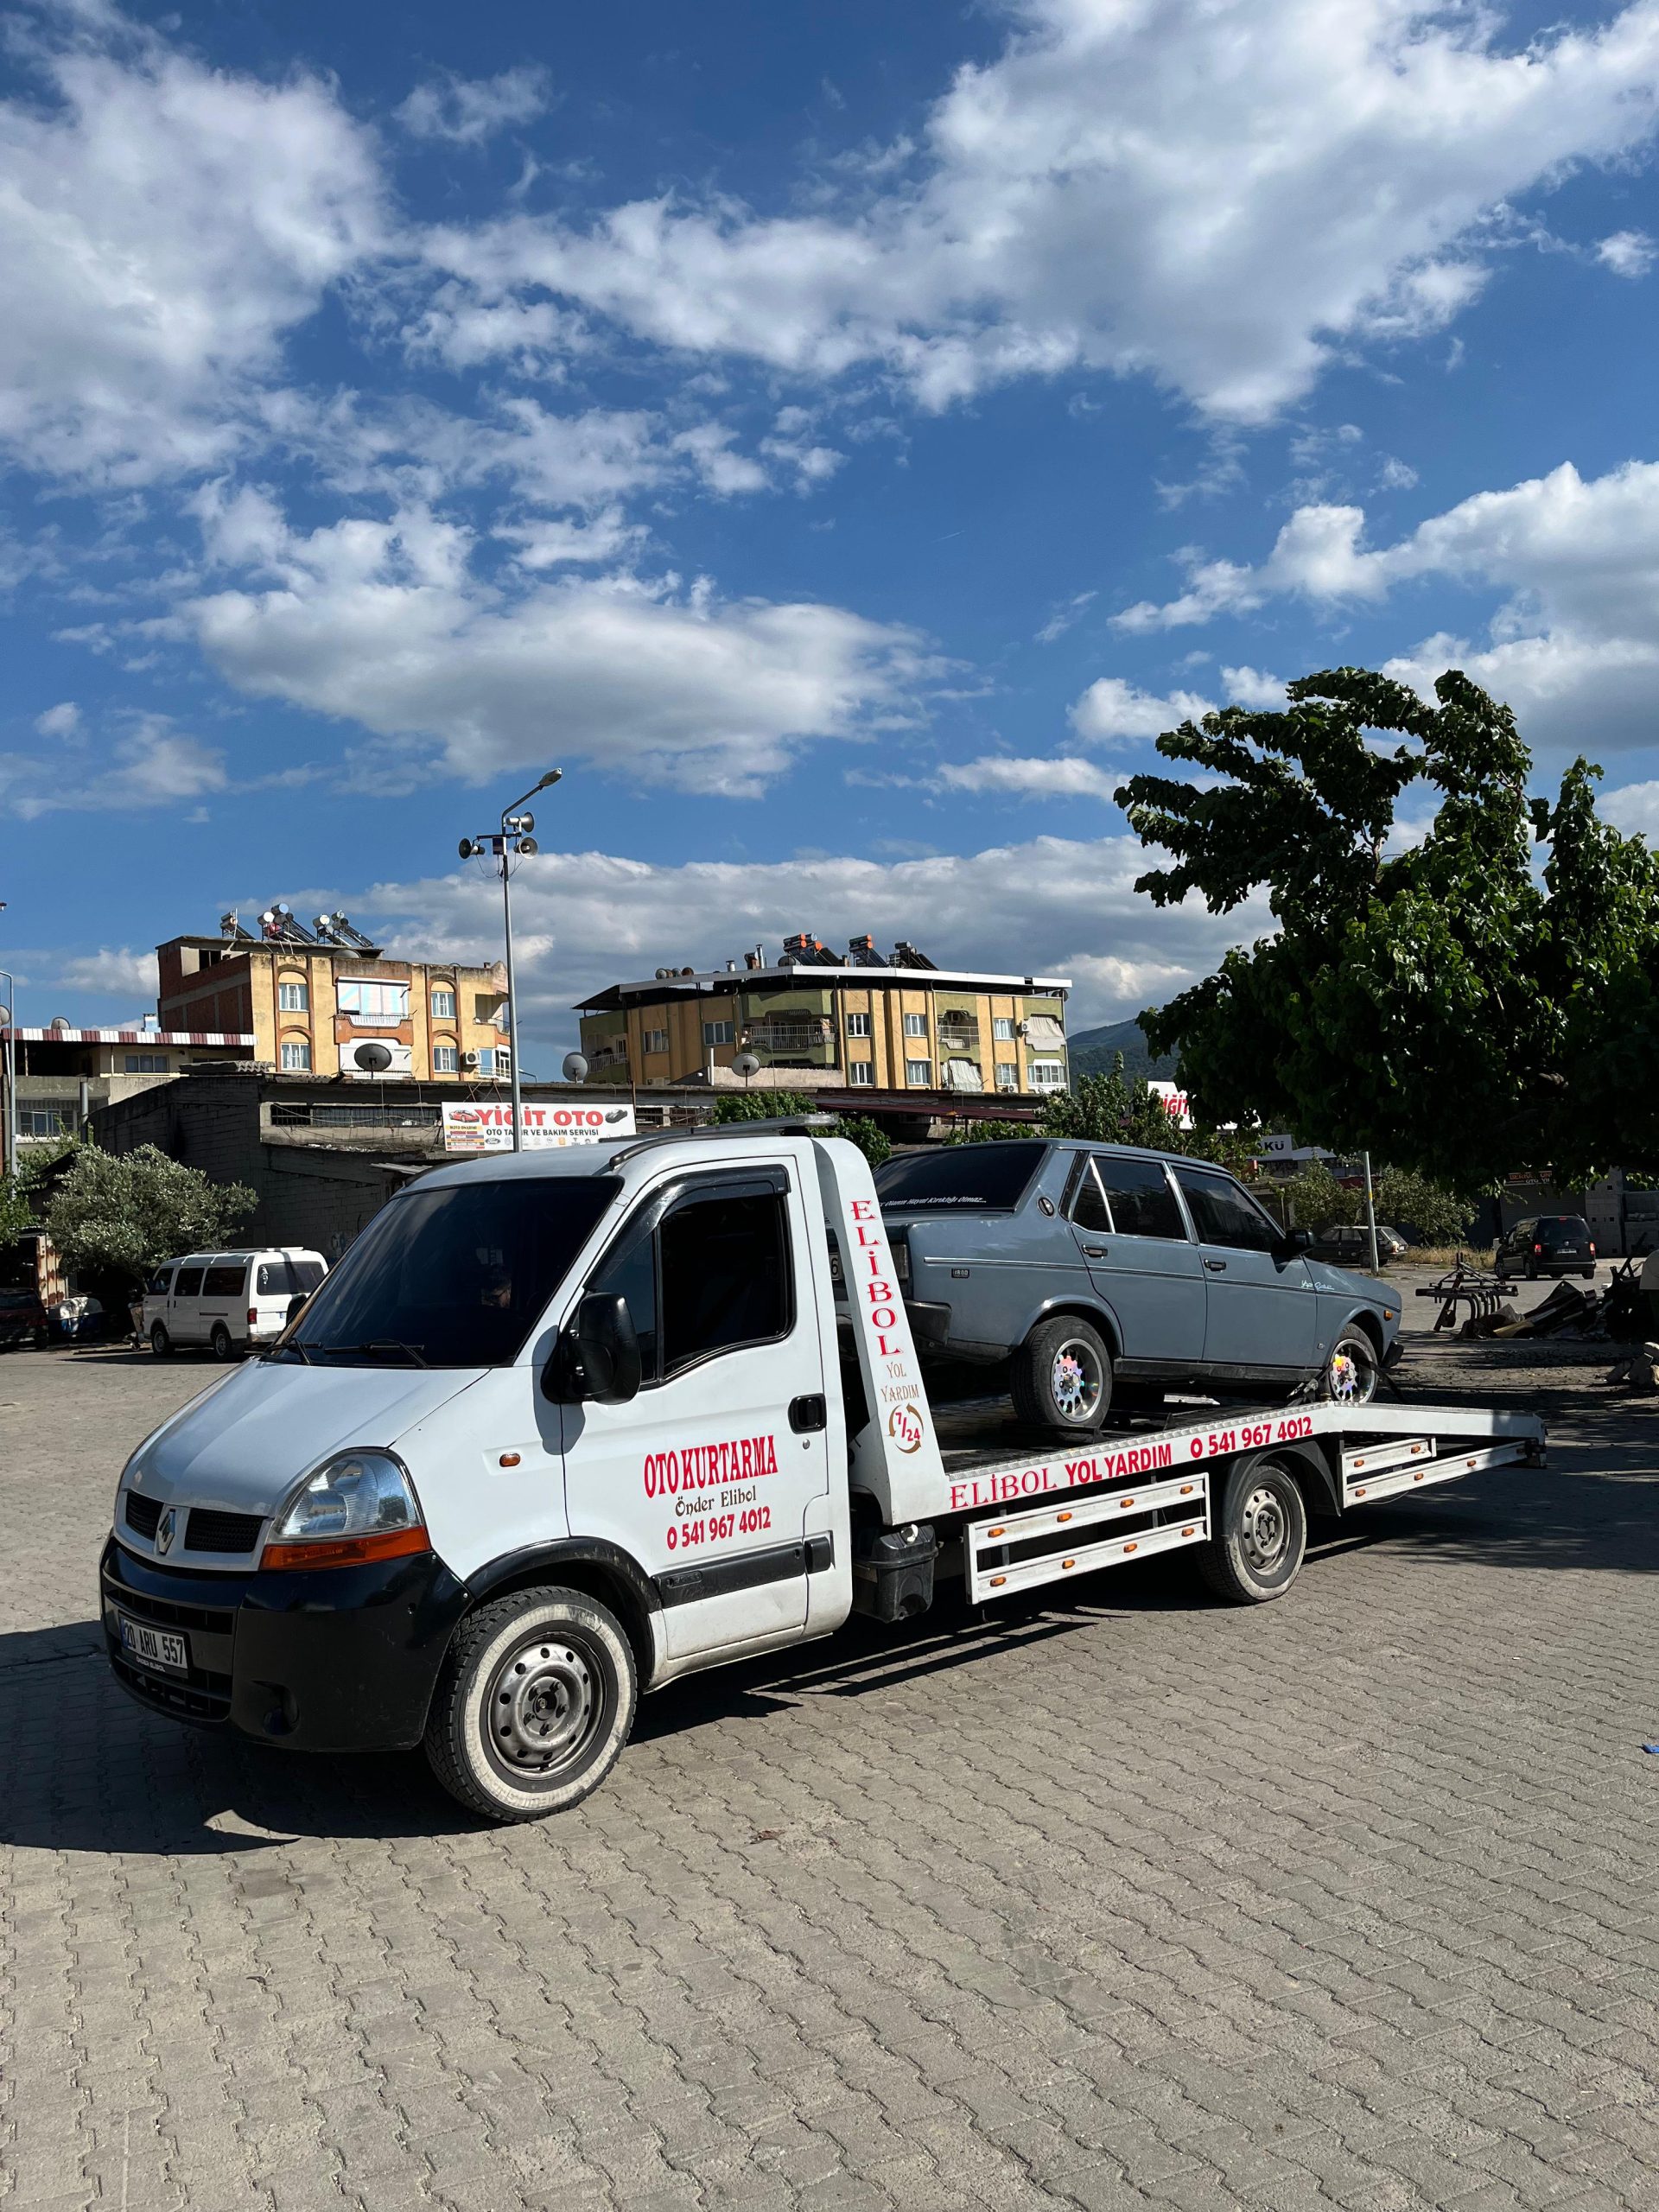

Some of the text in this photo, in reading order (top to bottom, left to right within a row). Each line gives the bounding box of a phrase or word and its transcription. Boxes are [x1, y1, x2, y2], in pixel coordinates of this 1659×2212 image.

[553, 1110, 604, 1127] OTO
[1162, 1094, 1188, 1115] İĞİT
[569, 1128, 599, 1136] SERVİSİ
[1257, 1141, 1285, 1151] KÜ
[849, 1199, 905, 1357] ELİBOL
[887, 1363, 907, 1379] YOL
[880, 1383, 920, 1403] YARDIM
[894, 1411, 921, 1442] 7/24
[644, 1434, 779, 1499] OTO KURTARMA
[950, 1468, 1058, 1510] ELİBOL
[1190, 1437, 1204, 1459] 0
[1208, 1430, 1236, 1456] 541
[1242, 1423, 1272, 1448] 967
[1277, 1416, 1313, 1440] 4012
[675, 1484, 757, 1517] Önder Elibol
[667, 1505, 772, 1550] 0 541 967 4012
[139, 1629, 158, 1658] ARU
[162, 1635, 183, 1665] 557
